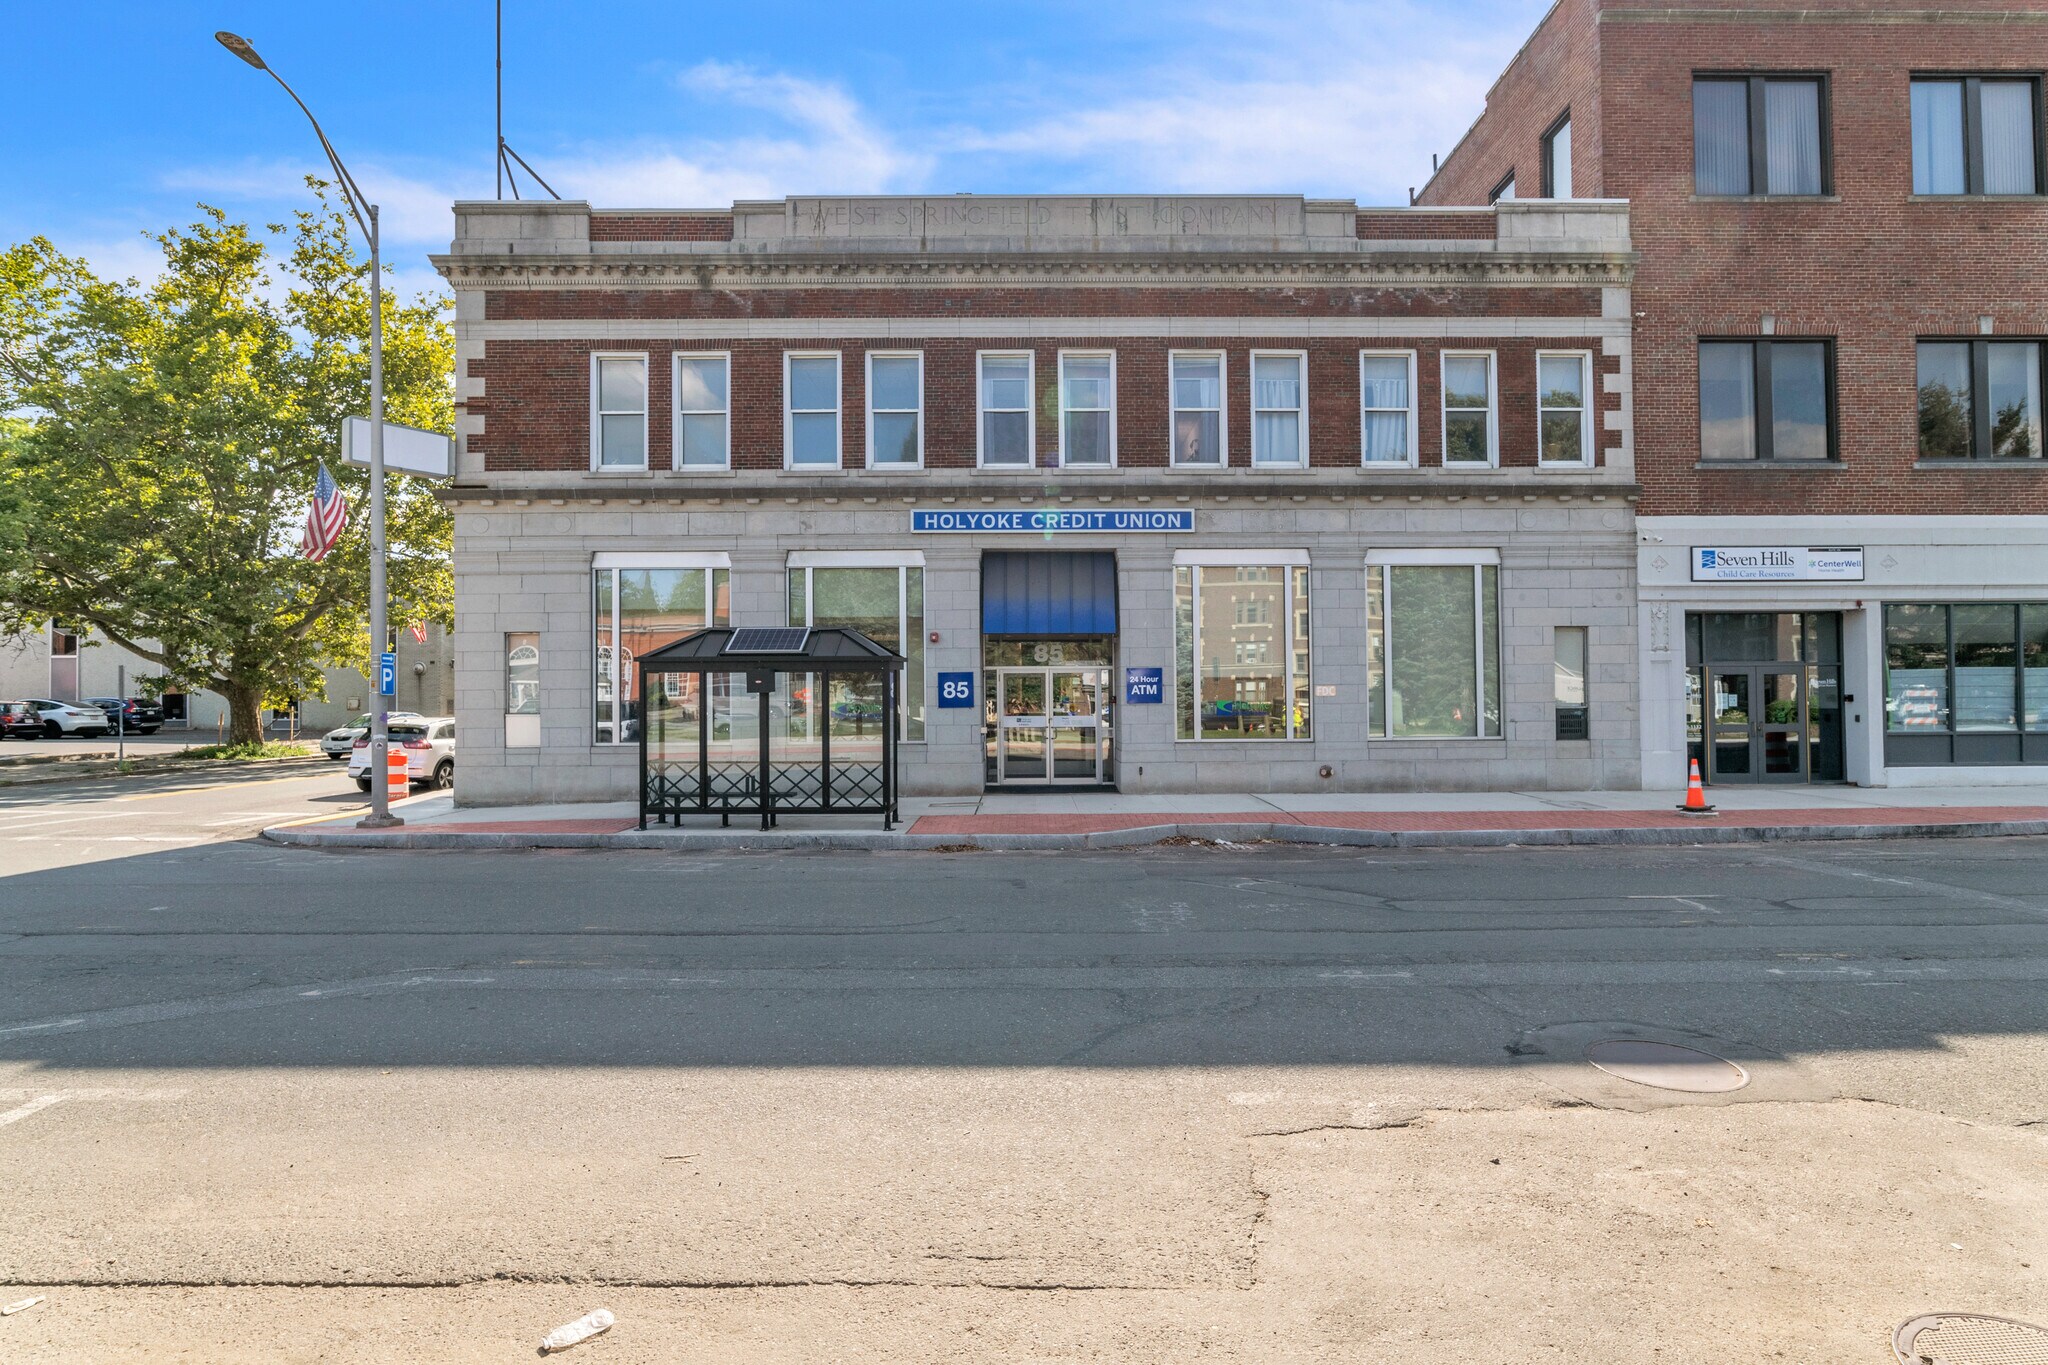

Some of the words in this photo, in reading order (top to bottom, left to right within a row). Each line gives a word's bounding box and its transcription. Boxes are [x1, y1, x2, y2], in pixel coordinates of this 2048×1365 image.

[809, 206, 882, 225] WEST
[895, 206, 1051, 225] SPRINGFIELD
[1160, 206, 1283, 225] COMPANY
[924, 513, 1023, 528] HOLYOKE
[1031, 513, 1106, 528] CREDIT
[1114, 513, 1181, 528] UNION
[1717, 551, 1757, 566] Seven
[1761, 551, 1795, 566] Hills
[1817, 560, 1862, 568] CenterWell
[1717, 570, 1738, 578] Child
[1740, 570, 1757, 578] Care
[1759, 570, 1795, 578] Resources
[1033, 644, 1064, 663] 85
[382, 668, 393, 691] P
[943, 682, 969, 699] 85
[1131, 684, 1158, 695] ATM
[1316, 685, 1336, 697] FDC
